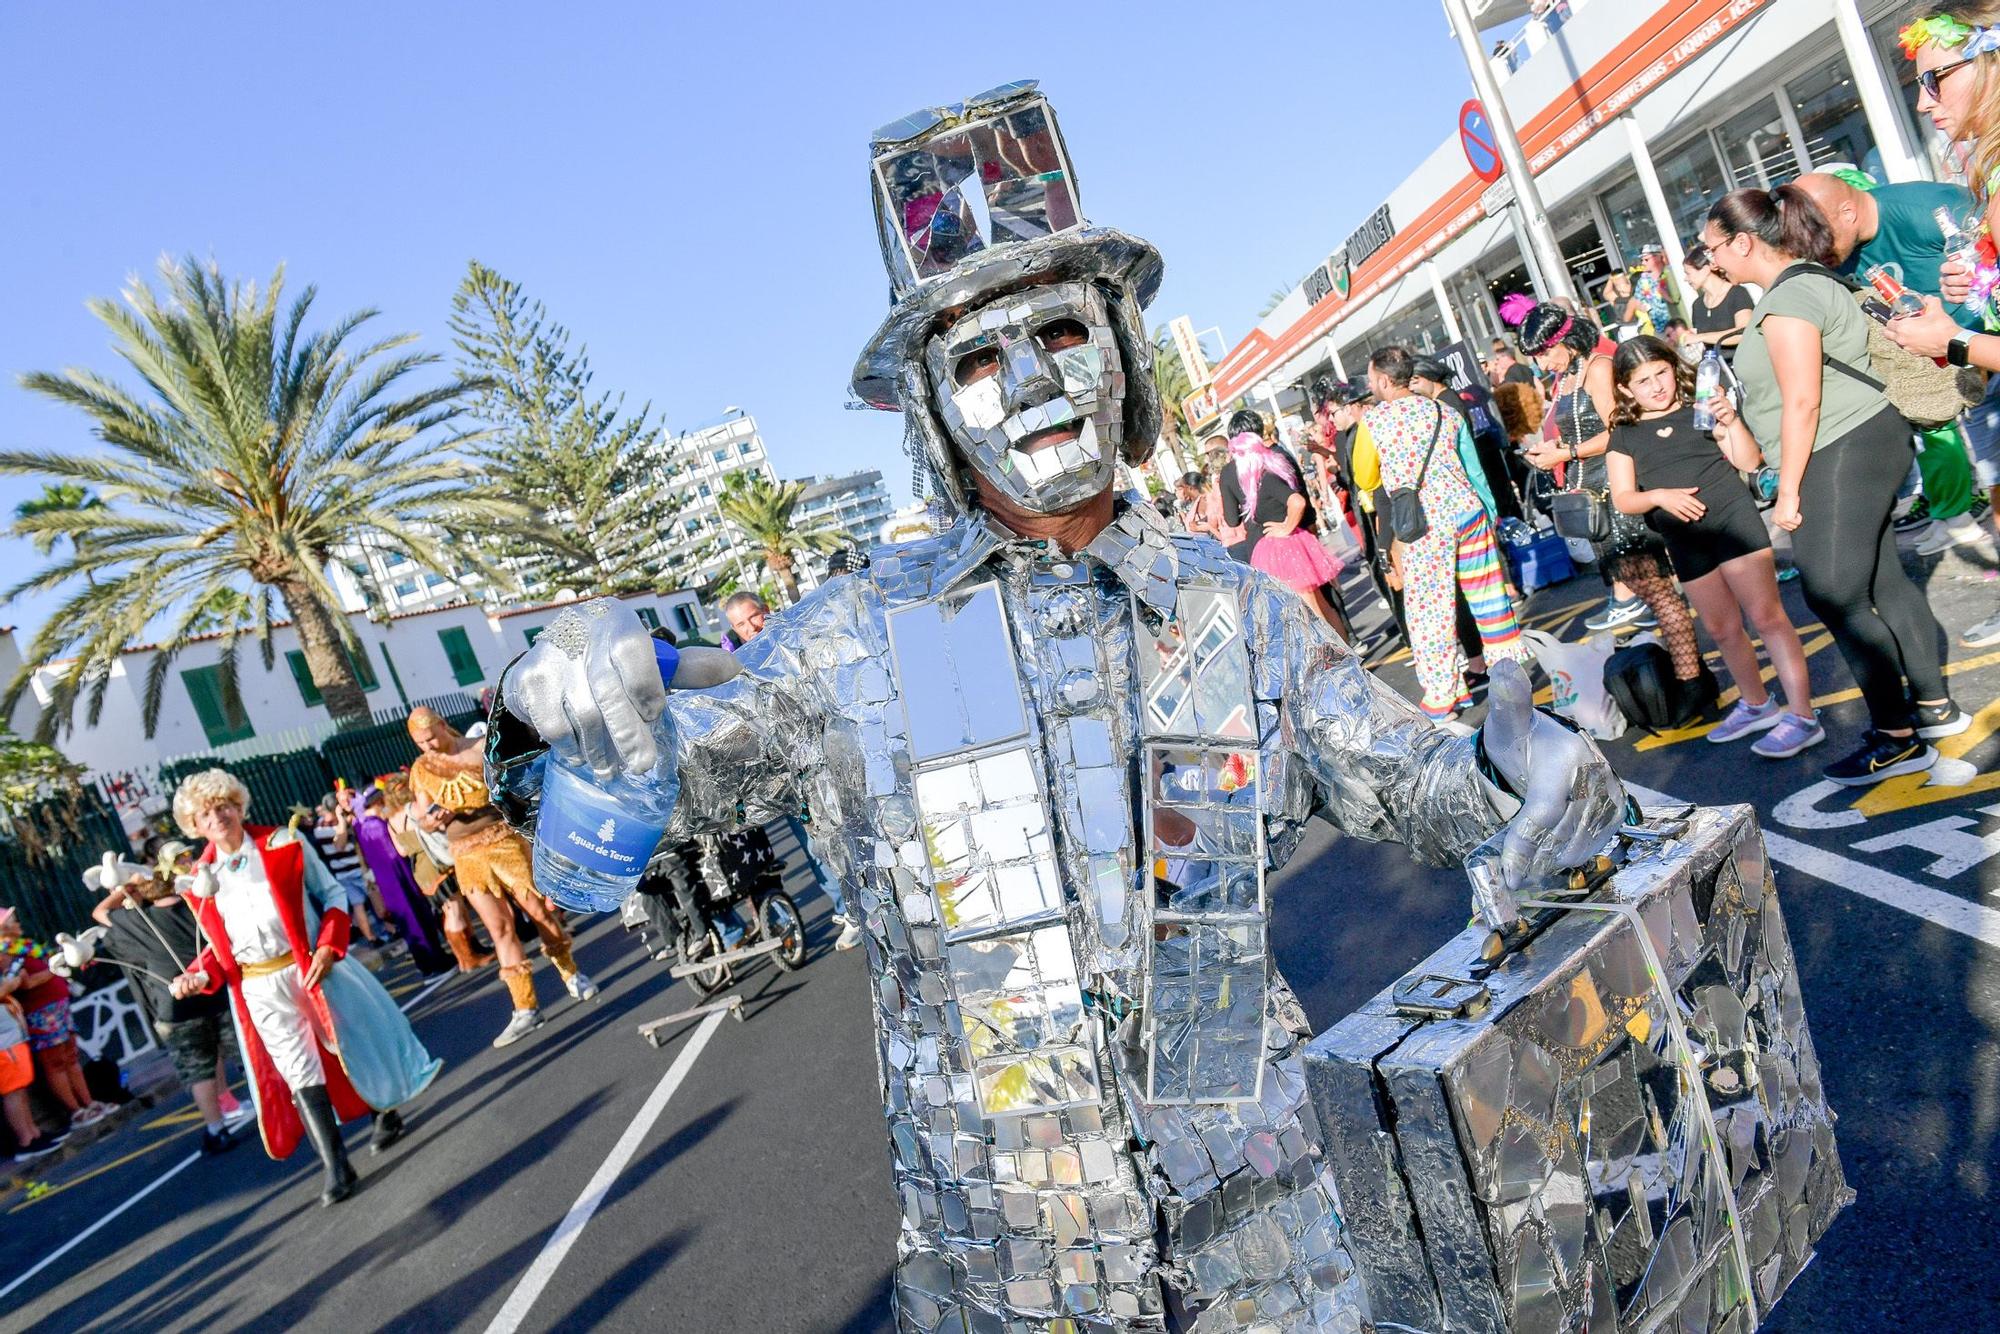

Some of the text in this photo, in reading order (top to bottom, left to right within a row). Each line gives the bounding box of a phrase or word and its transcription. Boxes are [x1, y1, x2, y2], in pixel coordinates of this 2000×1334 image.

[1673, 18, 1722, 63] LIQUOR
[1345, 203, 1396, 267] MARKET
[567, 831, 635, 863] Aguas de Teror
